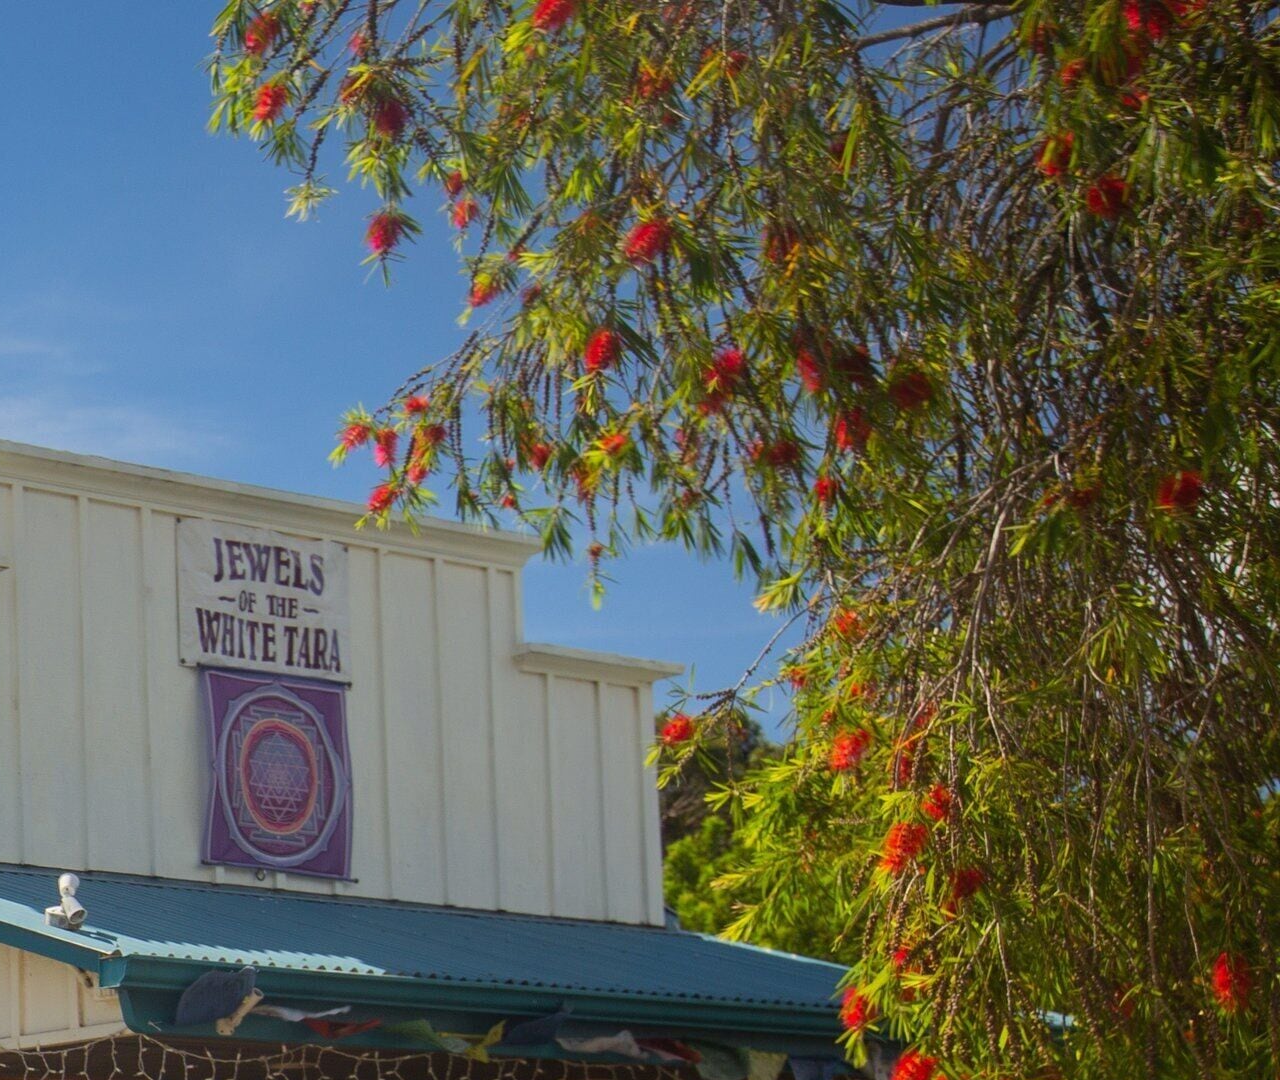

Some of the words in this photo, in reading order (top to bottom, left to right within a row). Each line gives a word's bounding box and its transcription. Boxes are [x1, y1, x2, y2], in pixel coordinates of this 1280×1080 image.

[213, 537, 325, 597] JEWELS
[239, 589, 256, 614] OF
[266, 594, 298, 619] THE
[195, 607, 277, 663] WHITE
[283, 625, 342, 674] TARA
